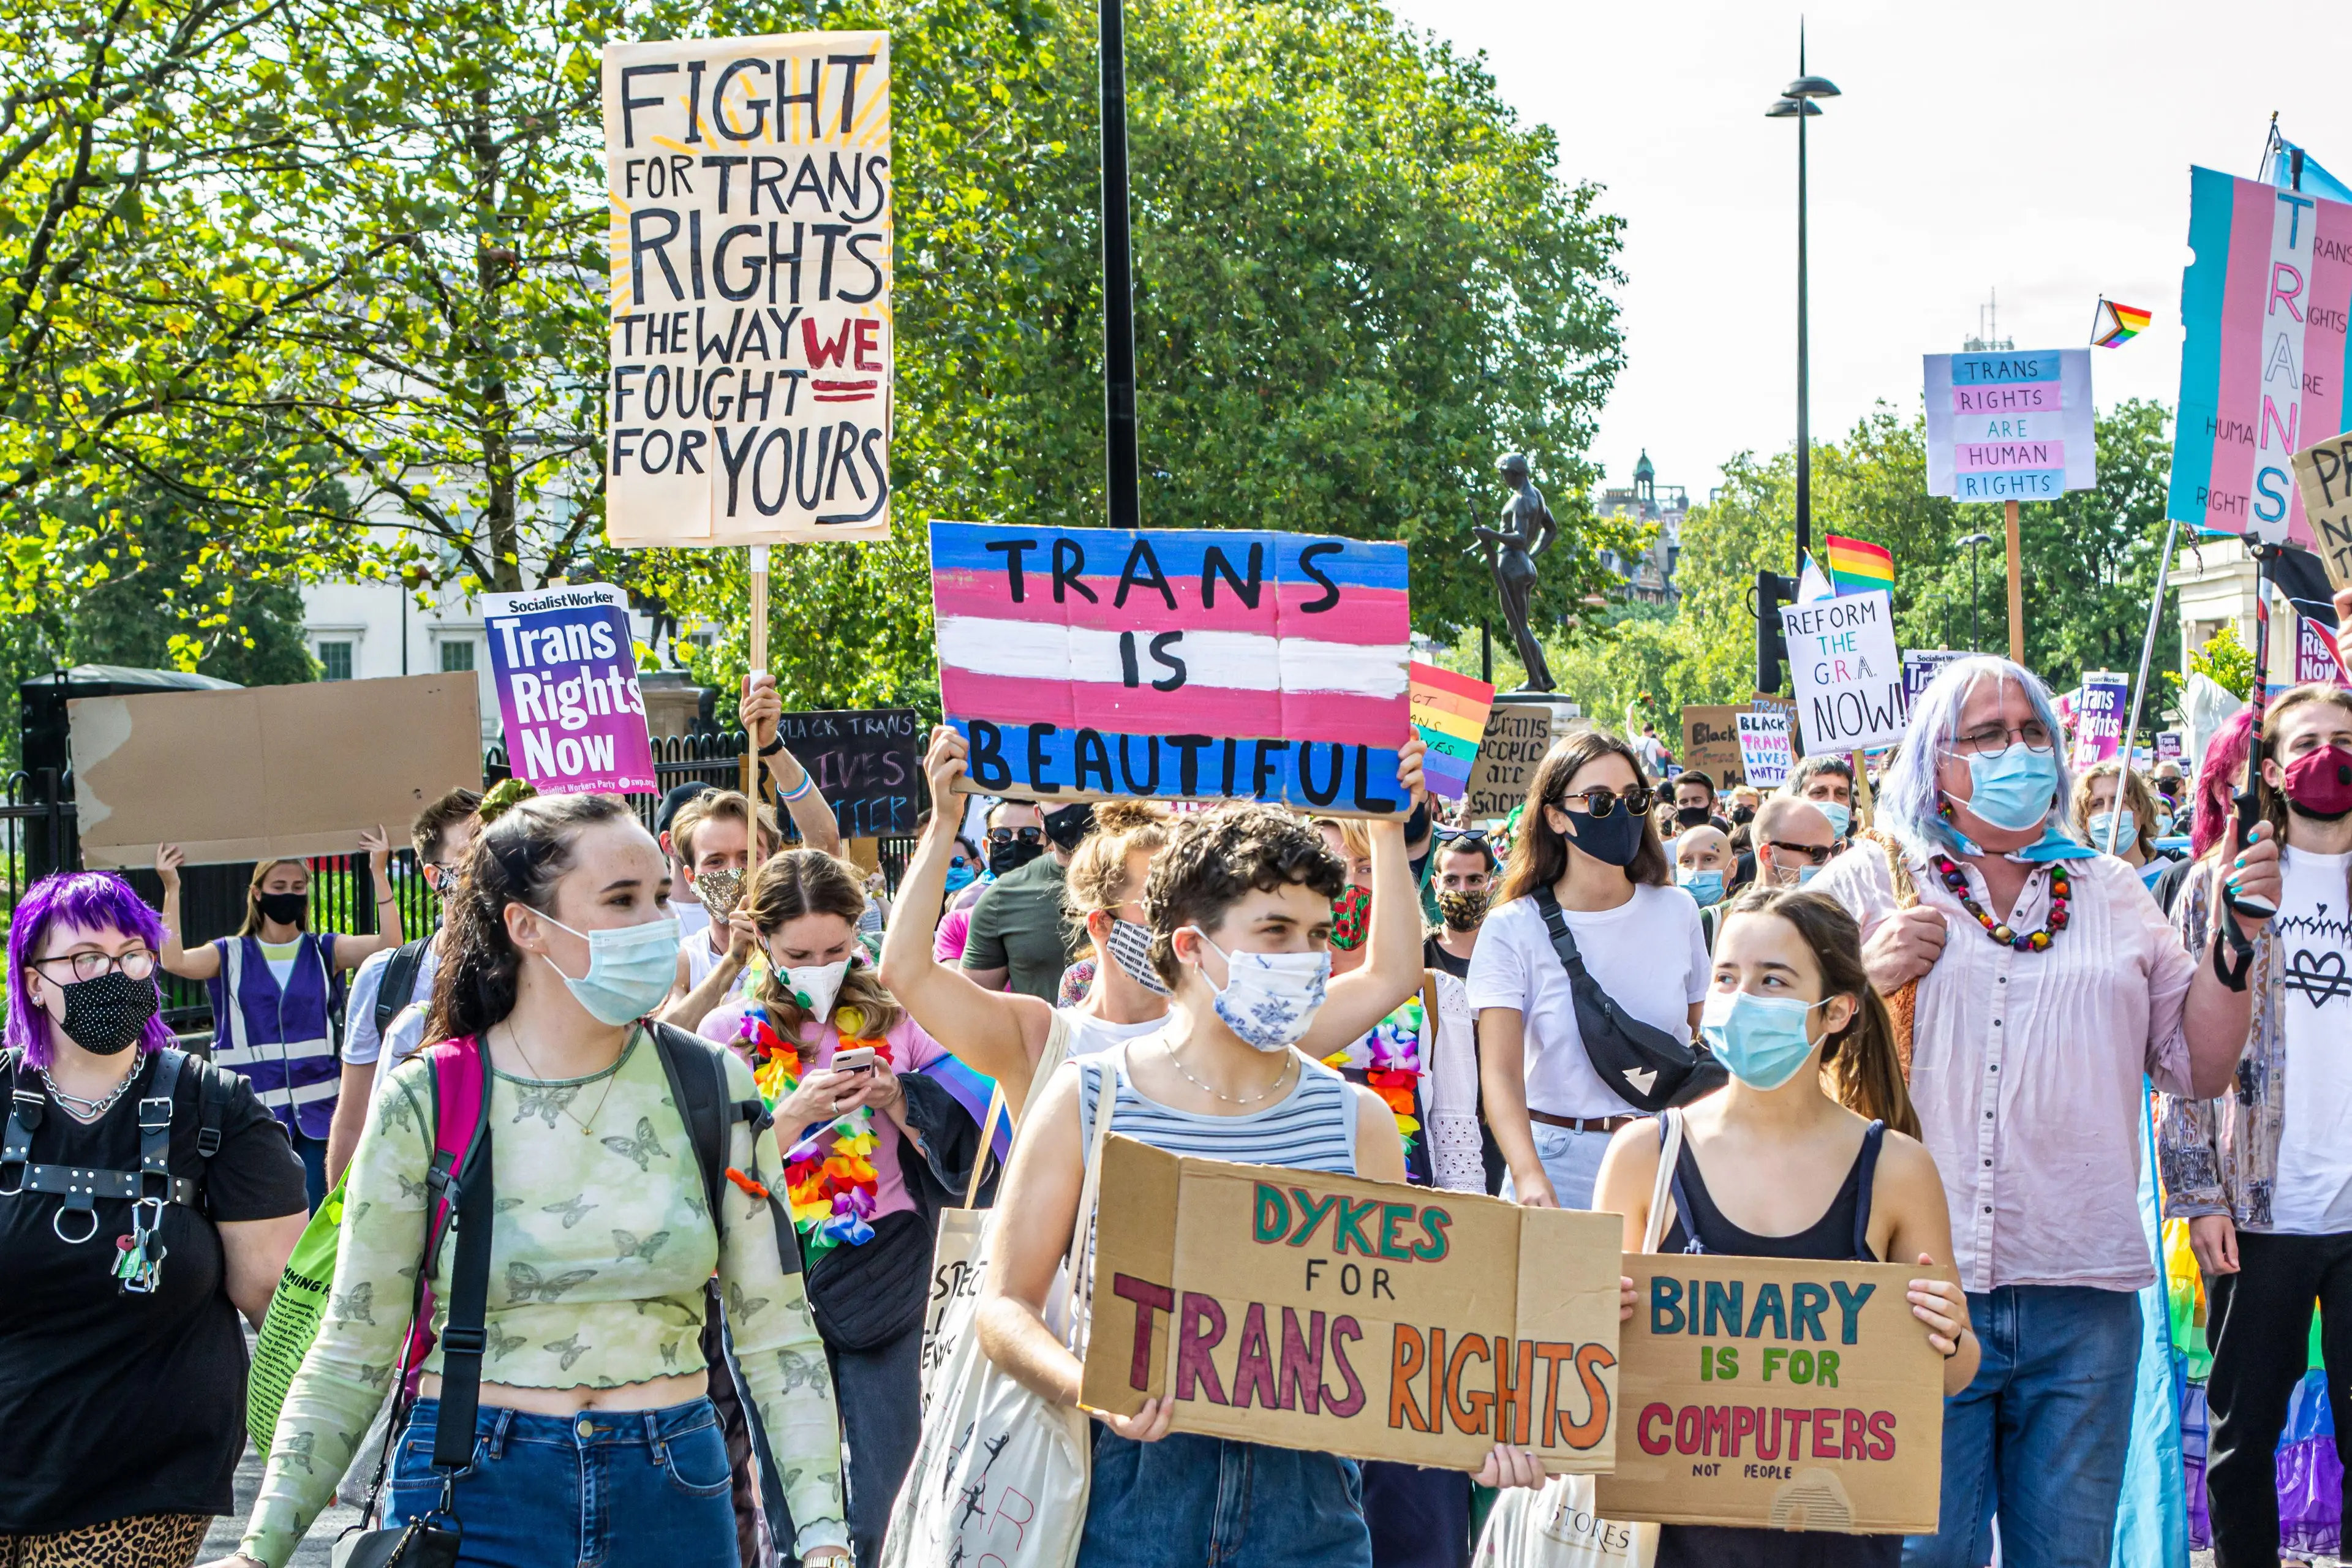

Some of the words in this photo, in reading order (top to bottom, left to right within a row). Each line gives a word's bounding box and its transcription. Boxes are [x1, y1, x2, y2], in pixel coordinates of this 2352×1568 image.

[621, 54, 876, 148] FIGHT
[626, 155, 693, 198] FOR
[702, 152, 888, 224] TRANS
[630, 209, 883, 305] RIGHTS
[614, 313, 688, 356] THE
[696, 307, 804, 365] WAY
[801, 316, 883, 371] WE
[1964, 360, 2038, 380] TRANS
[2254, 192, 2314, 524] TRANS
[614, 364, 808, 422] FOUGHT
[1961, 390, 2043, 410] RIGHTS
[1987, 420, 2027, 438] ARE
[1969, 445, 2047, 466] HUMAN
[613, 428, 707, 476] FOR
[714, 421, 888, 526] YOURS
[1966, 475, 2051, 496] RIGHTS
[2196, 485, 2249, 517] RIGHT
[986, 538, 1344, 613] TRANS
[508, 595, 567, 613] Socialist
[567, 591, 614, 606] Worker
[1786, 600, 1877, 636] REFORM
[492, 617, 617, 669] Trans
[1817, 631, 1858, 656] THE
[1119, 630, 1187, 692] IS
[1814, 656, 1878, 685] G.R.A.
[2301, 657, 2338, 680] Now
[510, 665, 644, 731] Rights
[1751, 699, 1798, 721] TRANS
[1814, 682, 1906, 742] NOW!
[2082, 684, 2115, 710] Trans
[2252, 674, 2267, 741] LEKI
[778, 717, 839, 738] BLACK
[848, 715, 913, 738] TRANS
[1692, 722, 1736, 745] Black
[1740, 716, 1785, 731] BLACK
[521, 727, 615, 780] Now
[1690, 747, 1735, 766] Trans
[1741, 734, 1789, 752] TRANS
[1744, 752, 1789, 766] LIVES
[812, 751, 905, 790] IVES
[967, 720, 1397, 813] BEAUTIFUL
[1486, 764, 1526, 784] are
[1750, 766, 1789, 782] MATTE
[567, 782, 597, 792] Workers
[597, 780, 616, 790] Party
[1252, 1180, 1452, 1263] DYKES
[1306, 1259, 1395, 1300] FOR
[289, 1298, 315, 1311] Ensemble
[1651, 1276, 1877, 1345] BINARY
[1113, 1272, 1367, 1418] TRANS
[1388, 1324, 1618, 1451] RIGHTS
[1701, 1346, 1740, 1381] IS
[1762, 1347, 1840, 1388] FOR
[1637, 1402, 1896, 1461] COMPUTERS
[1692, 1464, 1722, 1477] NOT
[1744, 1464, 1792, 1479] PEOPLE
